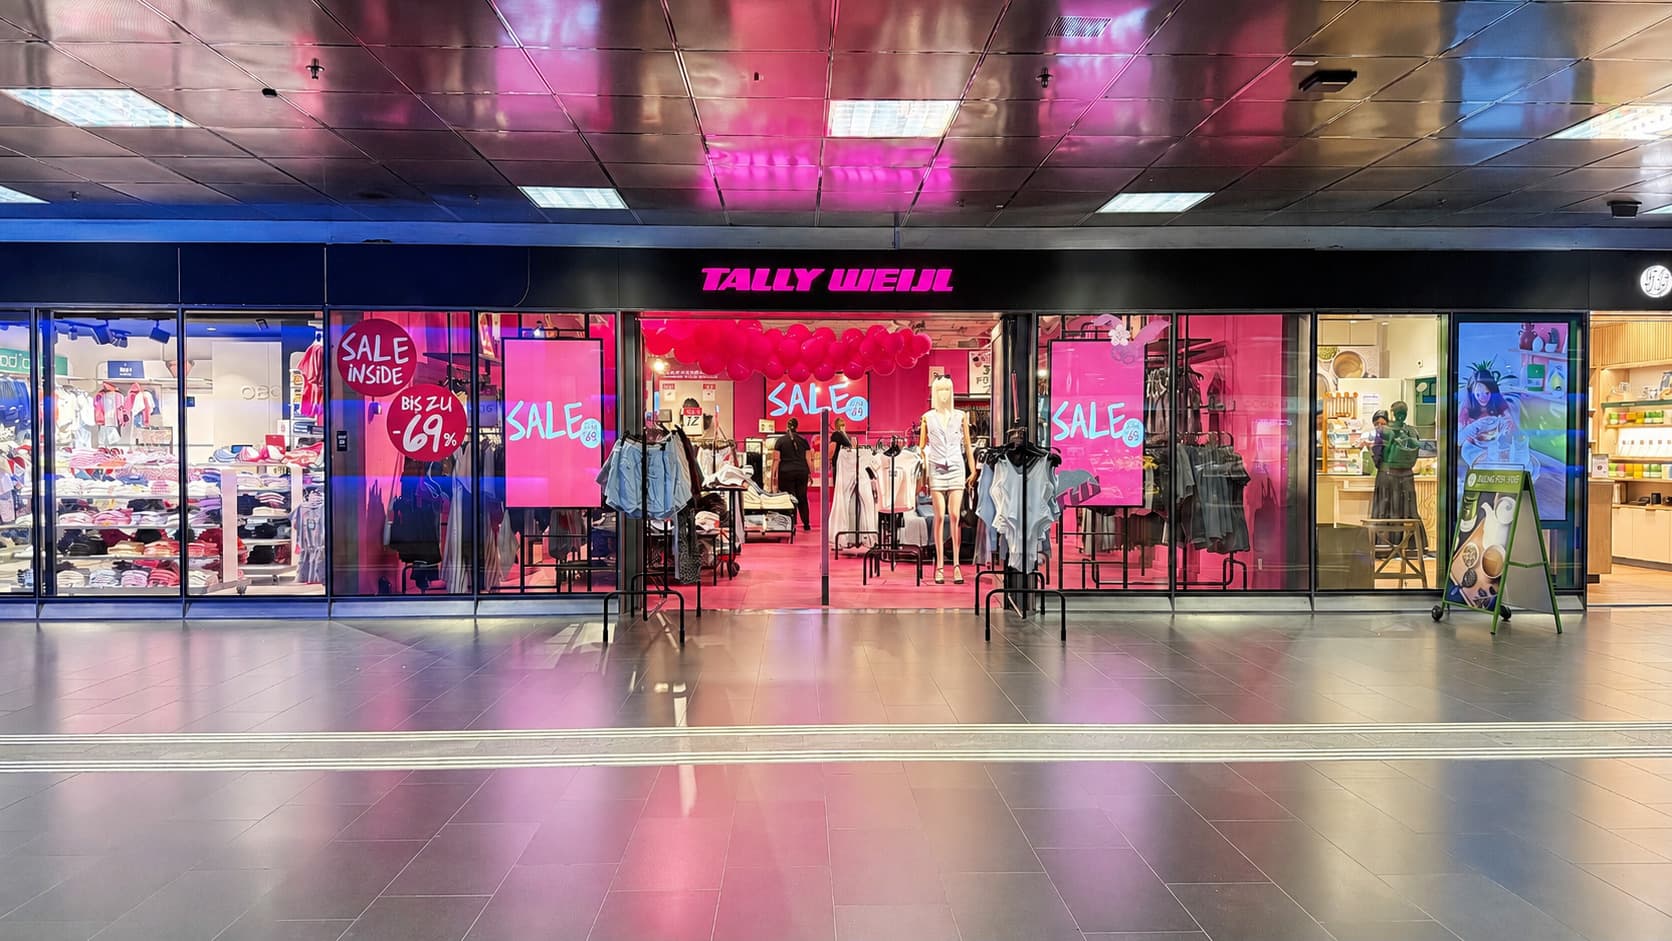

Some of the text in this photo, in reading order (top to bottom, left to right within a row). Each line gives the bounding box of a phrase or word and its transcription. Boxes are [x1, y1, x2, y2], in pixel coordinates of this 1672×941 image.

[702, 267, 953, 292] TALLY WEIJL
[341, 332, 409, 364] SALE
[347, 363, 403, 385] INSIDE
[425, 396, 452, 412] ZU
[768, 382, 850, 416] SALE
[506, 401, 583, 441] SALE
[1052, 401, 1125, 441] SALE
